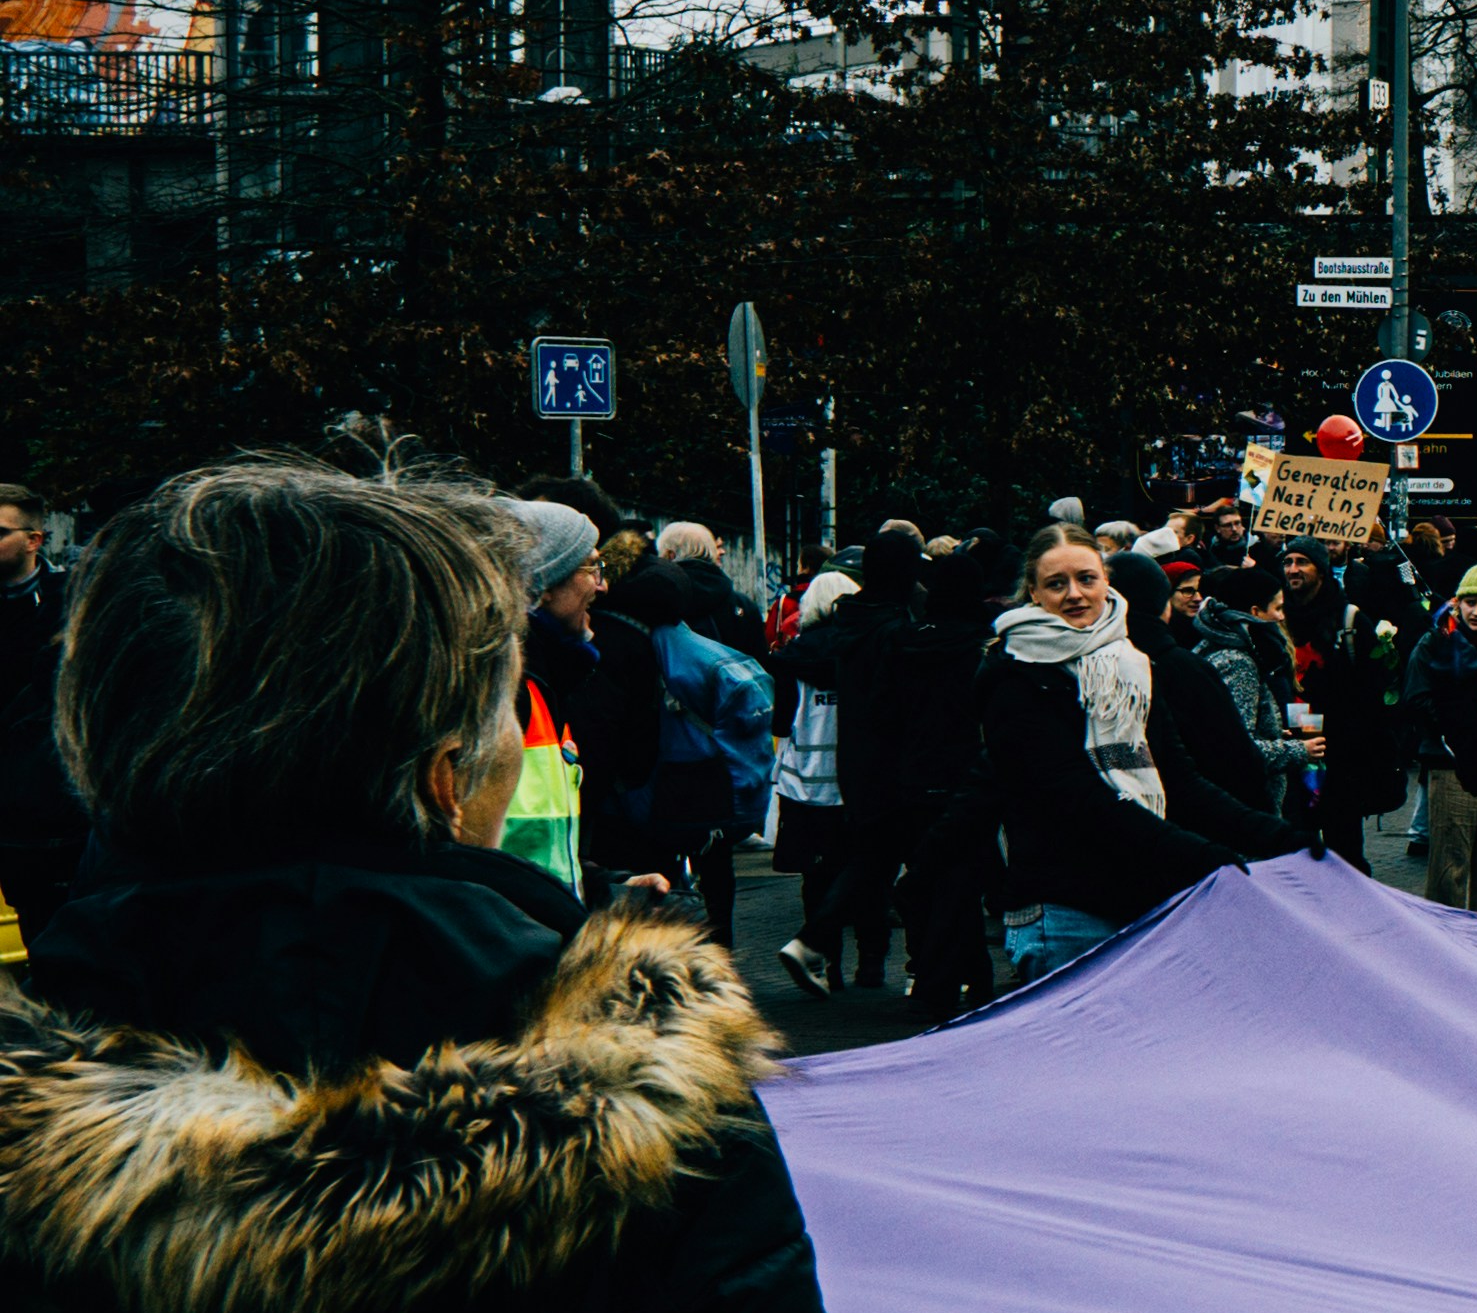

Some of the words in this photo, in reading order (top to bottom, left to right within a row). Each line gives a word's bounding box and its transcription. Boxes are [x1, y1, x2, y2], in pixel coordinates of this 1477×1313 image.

[1317, 262, 1391, 275] Bootshausstraße
[1302, 289, 1318, 303] Zu
[1321, 290, 1342, 304] den
[1346, 290, 1388, 305] Mühlen
[1277, 460, 1379, 493] Generation
[1272, 485, 1317, 510] Nazi
[1328, 492, 1365, 520] ins
